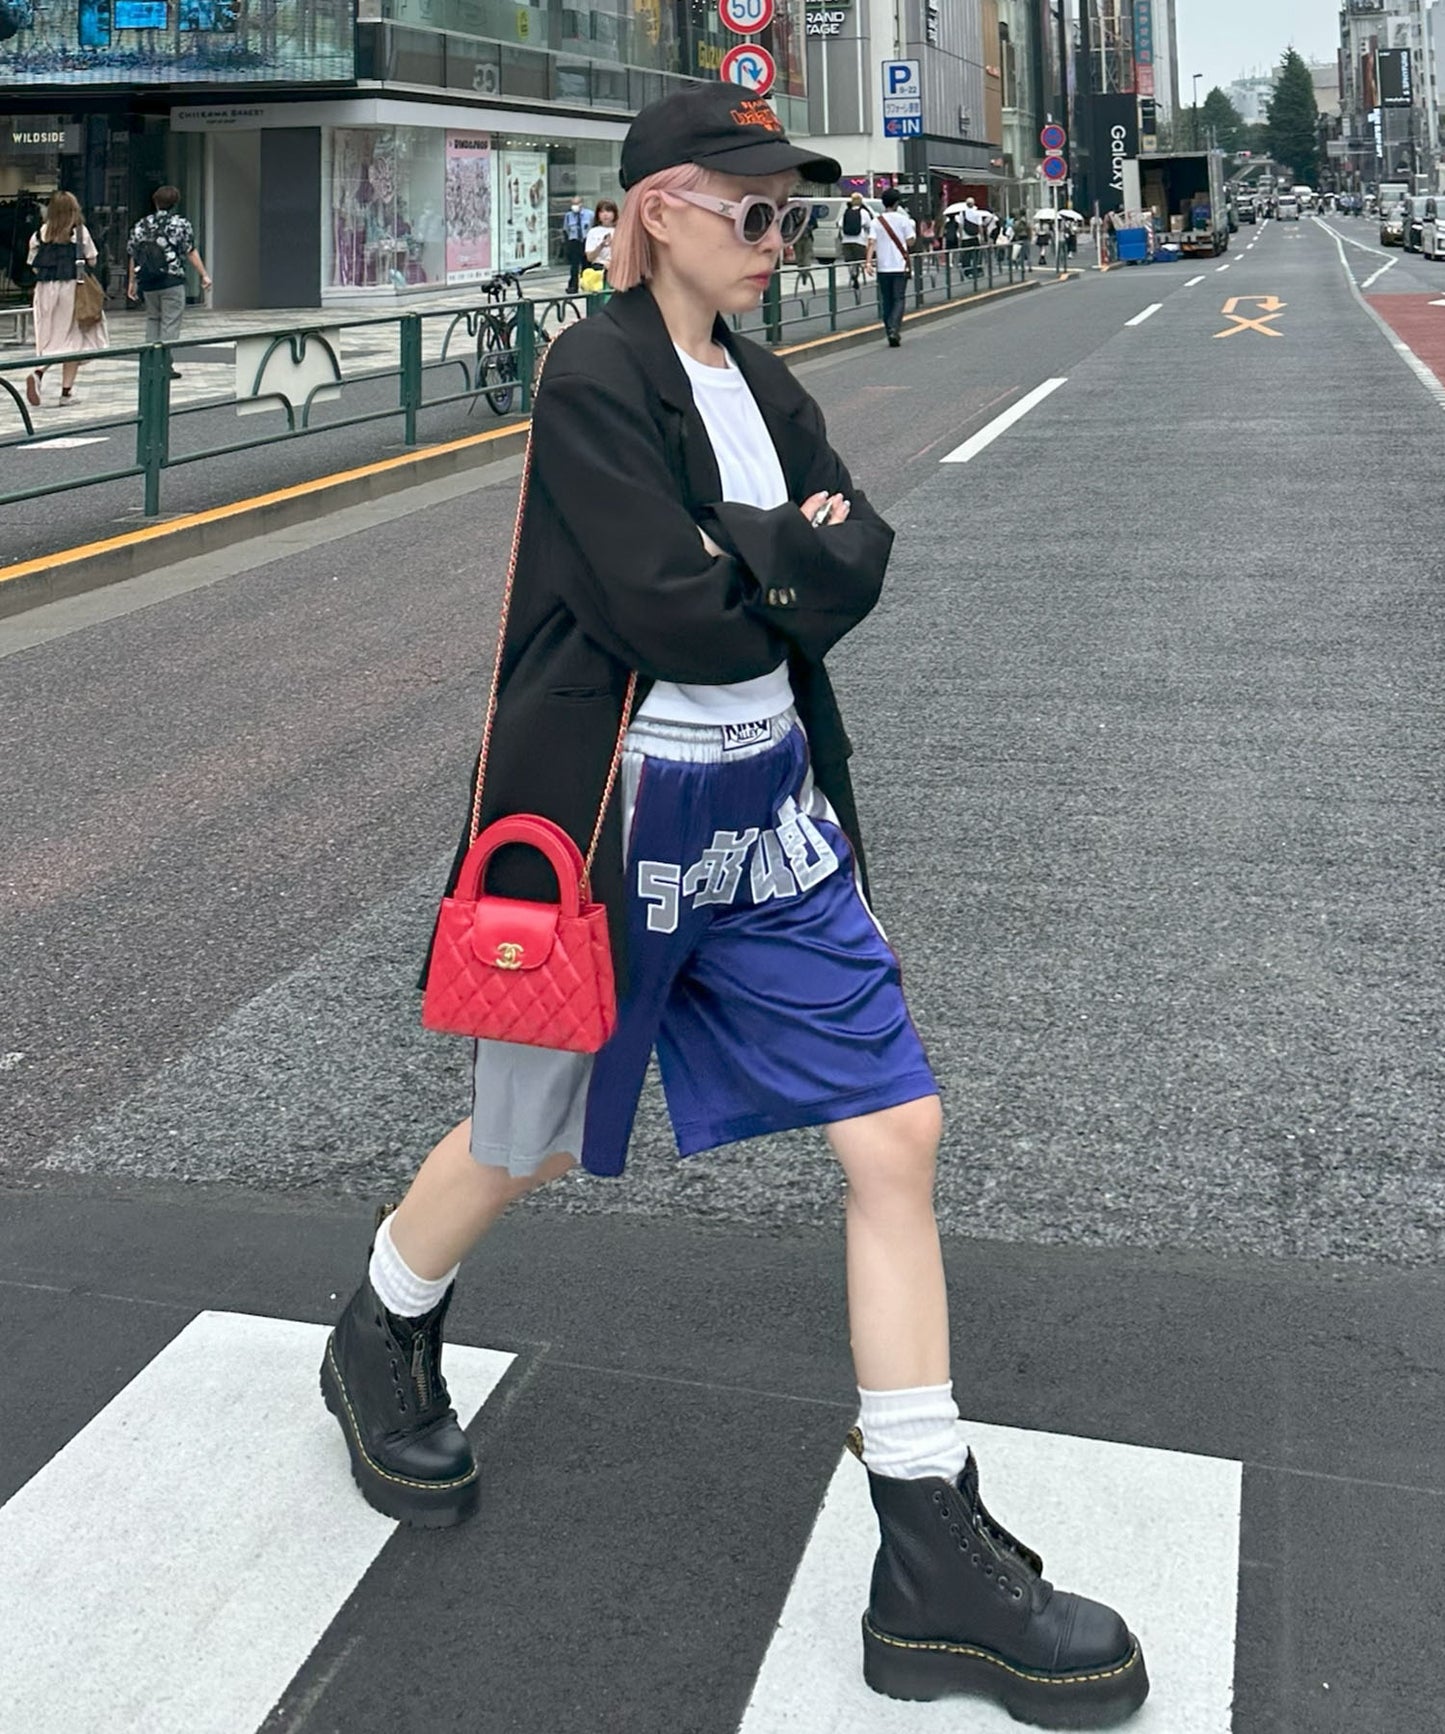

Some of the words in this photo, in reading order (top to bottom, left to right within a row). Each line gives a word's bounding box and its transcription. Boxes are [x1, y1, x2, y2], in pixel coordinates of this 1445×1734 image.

[732, 0, 761, 19] 50
[806, 11, 845, 23] RAND
[806, 23, 840, 35] TAGE
[889, 65, 912, 94] P
[902, 118, 921, 134] IN
[12, 131, 66, 143] WILDSIDE
[1109, 125, 1127, 191] Galaxy
